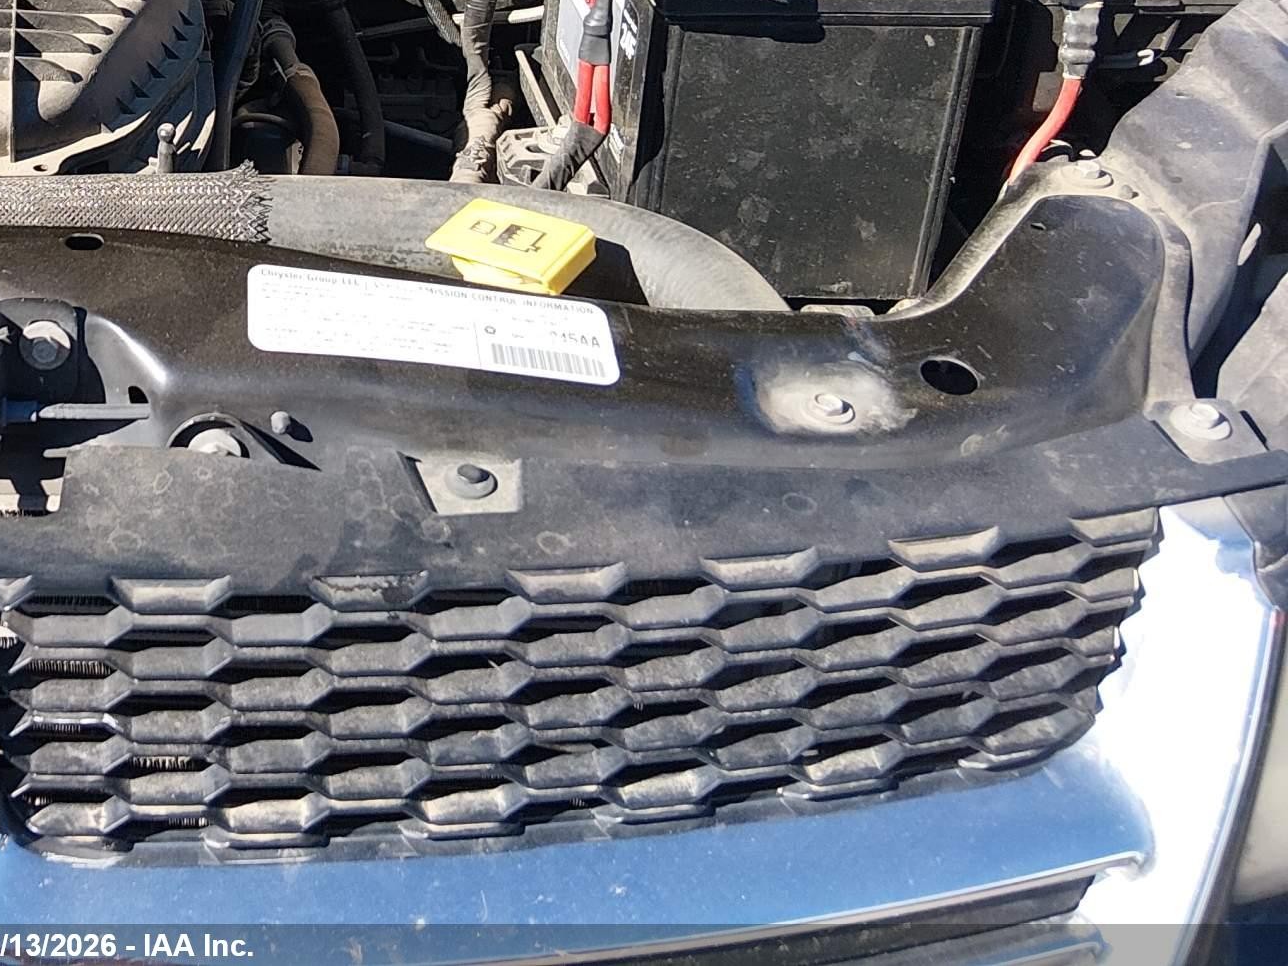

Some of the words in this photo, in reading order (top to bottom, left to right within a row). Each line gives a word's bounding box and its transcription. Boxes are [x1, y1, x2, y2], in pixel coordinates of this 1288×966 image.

[260, 268, 303, 280] Chrysler
[306, 274, 338, 285] Group
[471, 292, 517, 306] CONTROL
[522, 300, 594, 315] INFORMATION
